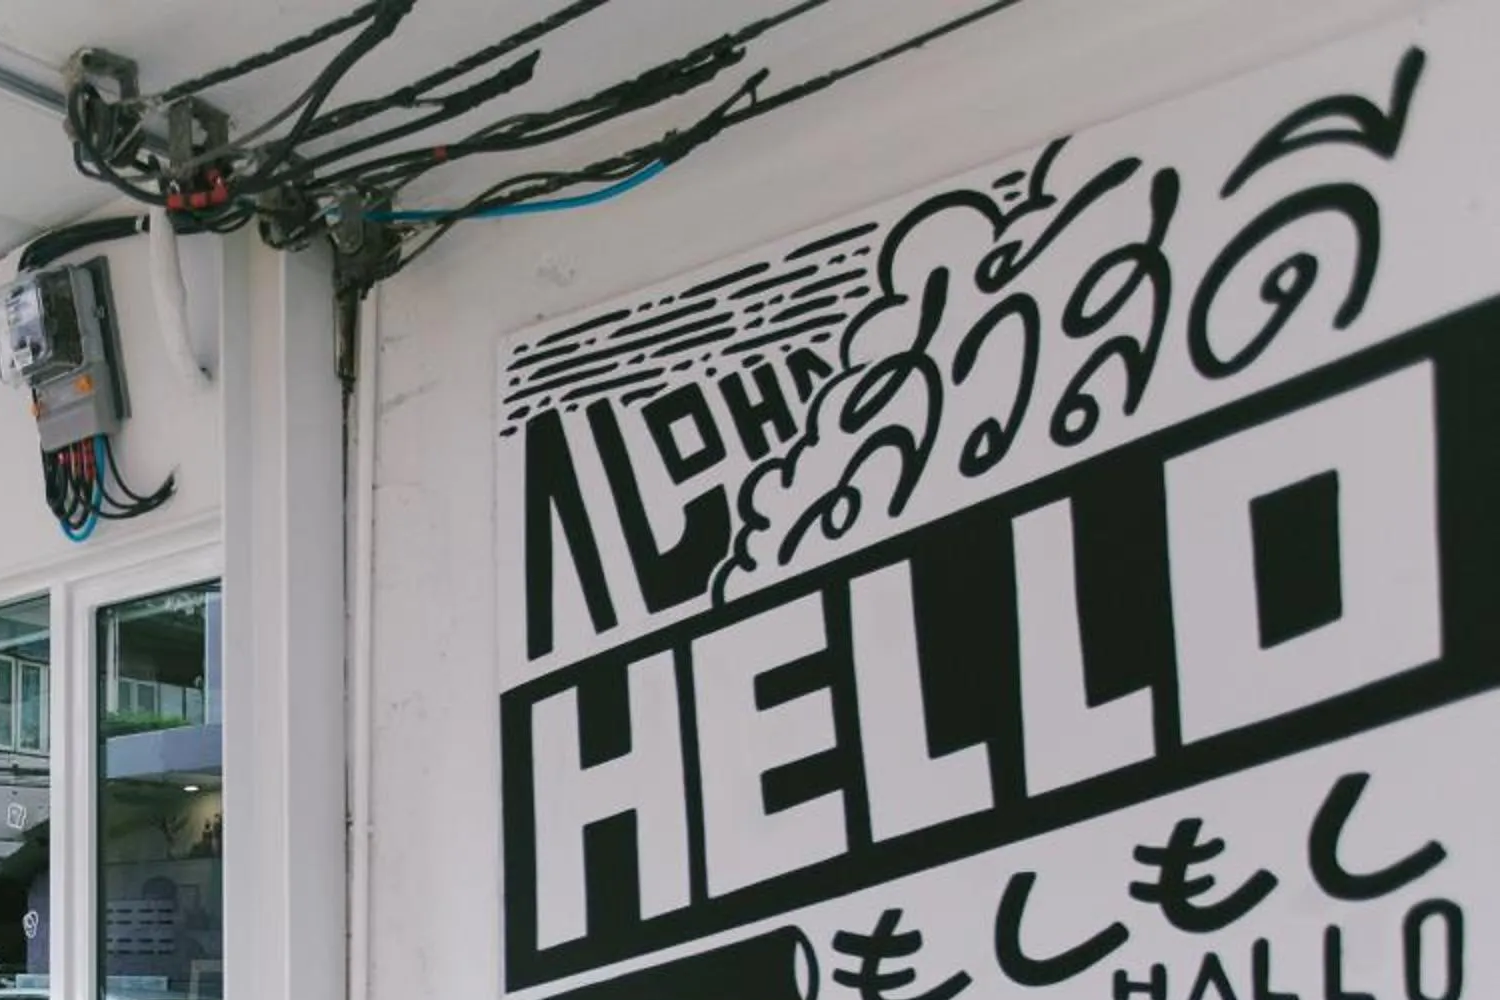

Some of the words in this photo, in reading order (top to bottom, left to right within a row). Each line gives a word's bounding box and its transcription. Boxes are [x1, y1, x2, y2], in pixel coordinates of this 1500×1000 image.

[779, 46, 1427, 566] สวัสดี
[529, 356, 1443, 952] HELLO
